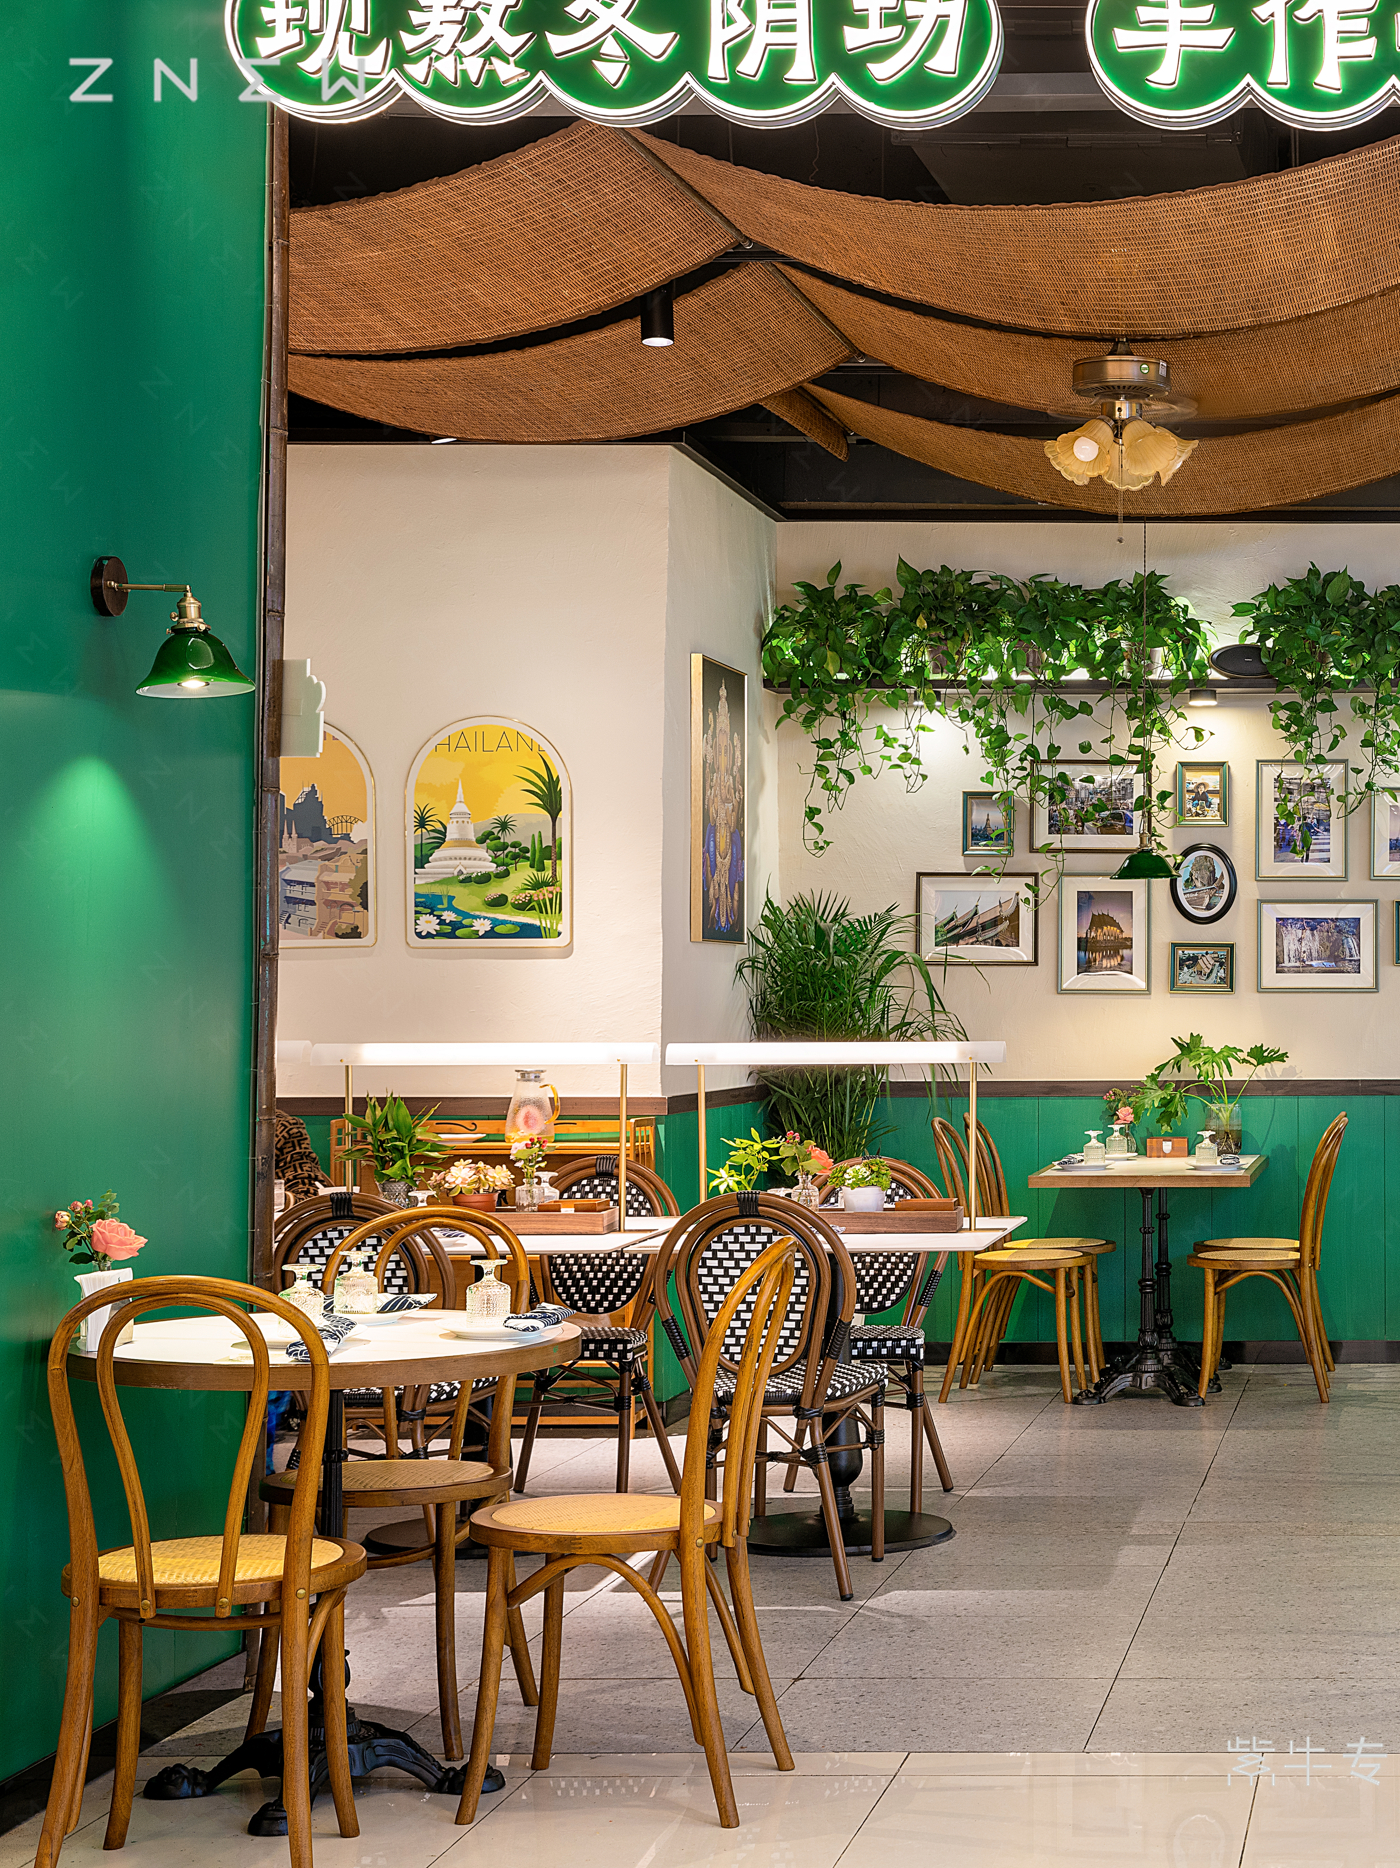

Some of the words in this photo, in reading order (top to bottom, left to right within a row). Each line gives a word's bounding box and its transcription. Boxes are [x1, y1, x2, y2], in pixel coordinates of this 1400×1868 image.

[256, 0, 966, 88] 现熬冬阴功
